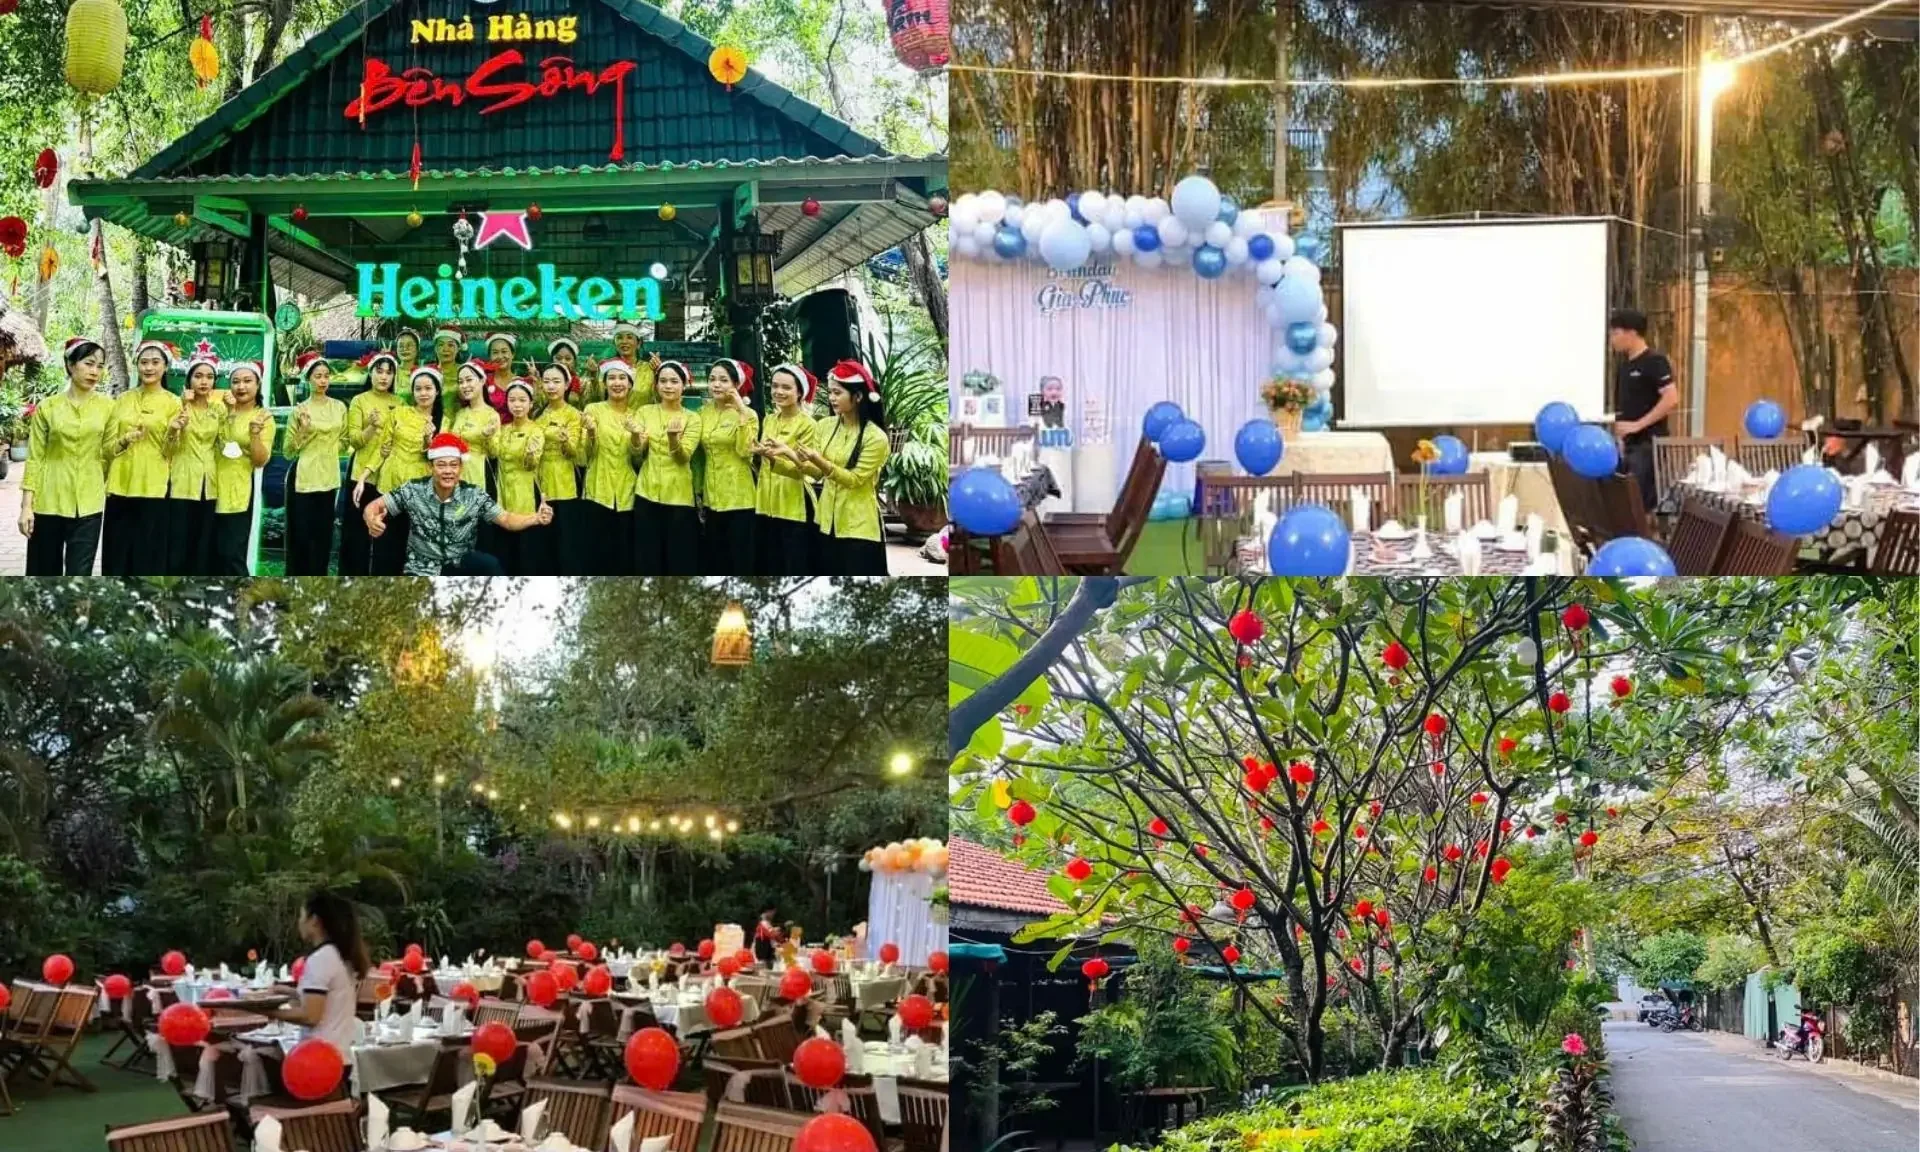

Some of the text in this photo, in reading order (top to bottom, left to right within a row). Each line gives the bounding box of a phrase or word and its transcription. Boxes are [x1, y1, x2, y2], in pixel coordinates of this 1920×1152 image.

[410, 13, 578, 44] Nhà Hàng
[465, 49, 638, 161] Sông
[354, 262, 667, 321] Heineken
